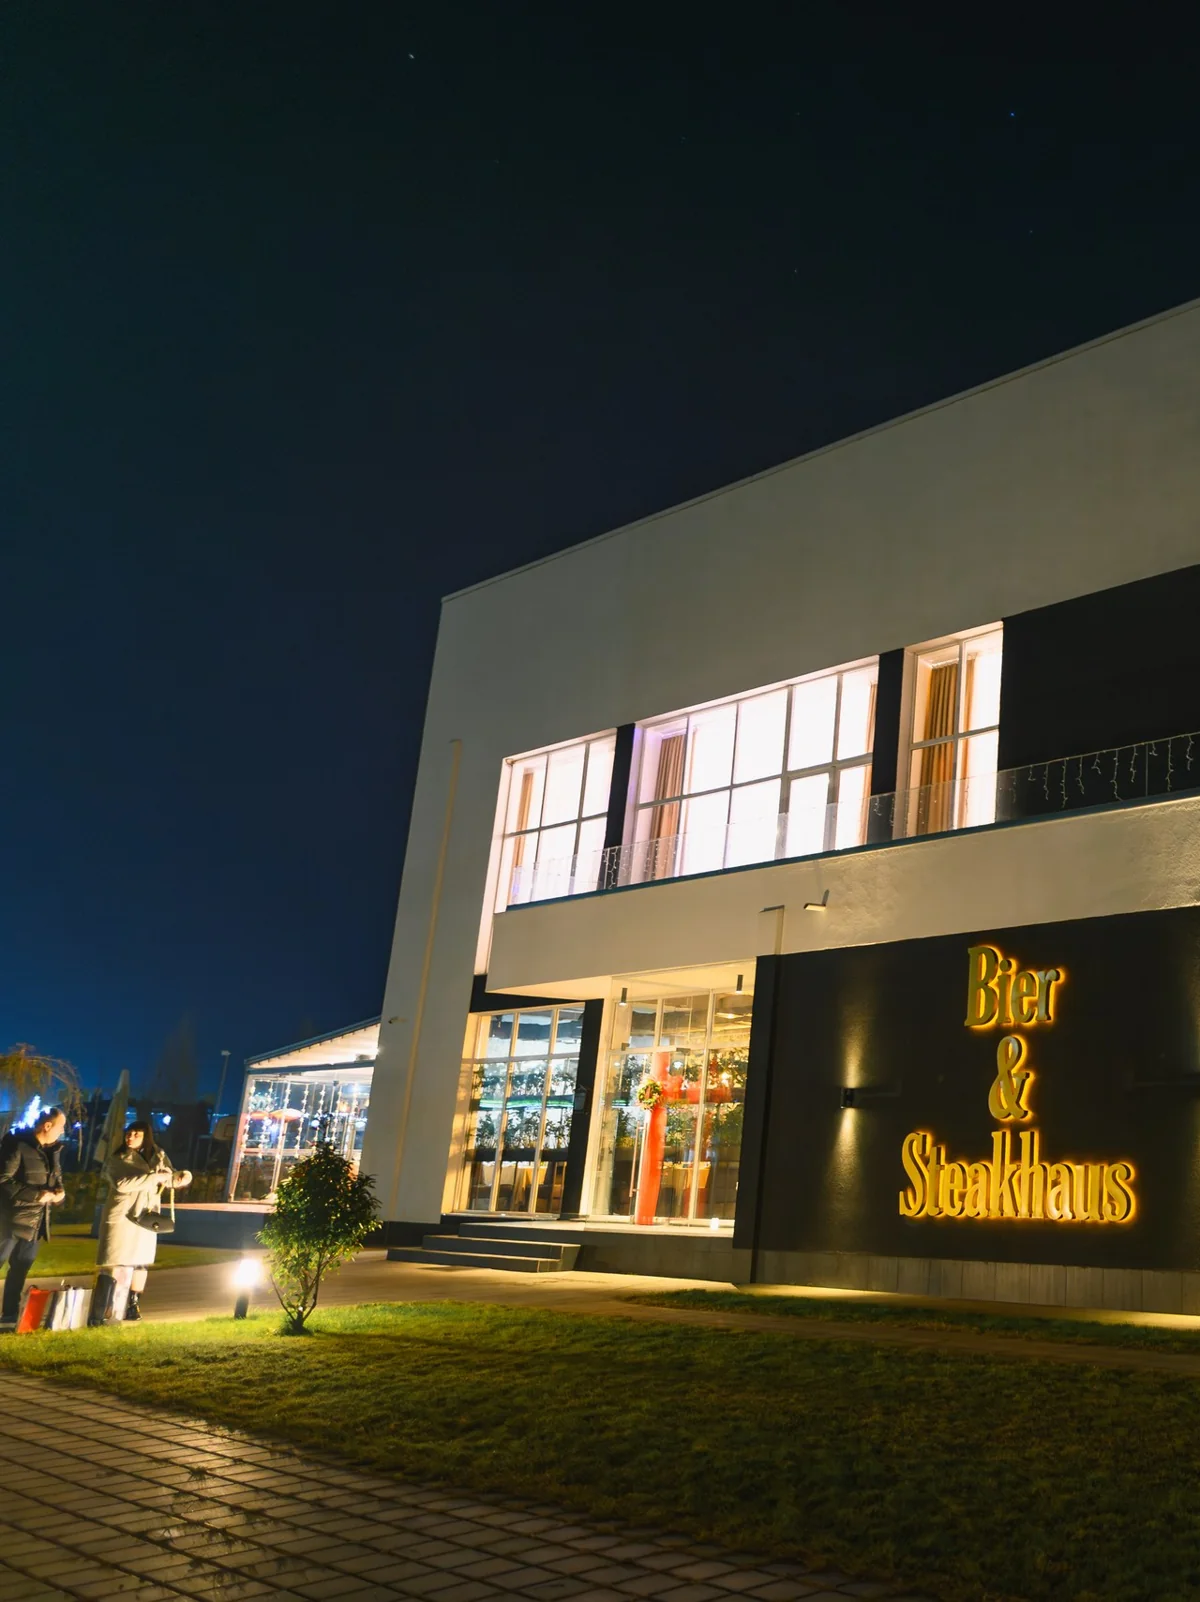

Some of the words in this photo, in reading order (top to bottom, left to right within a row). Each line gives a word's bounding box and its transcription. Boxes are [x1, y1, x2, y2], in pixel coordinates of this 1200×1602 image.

[964, 946, 1061, 1027] Bier
[988, 1035, 1030, 1121] &
[899, 1131, 1133, 1221] Steakhaus
